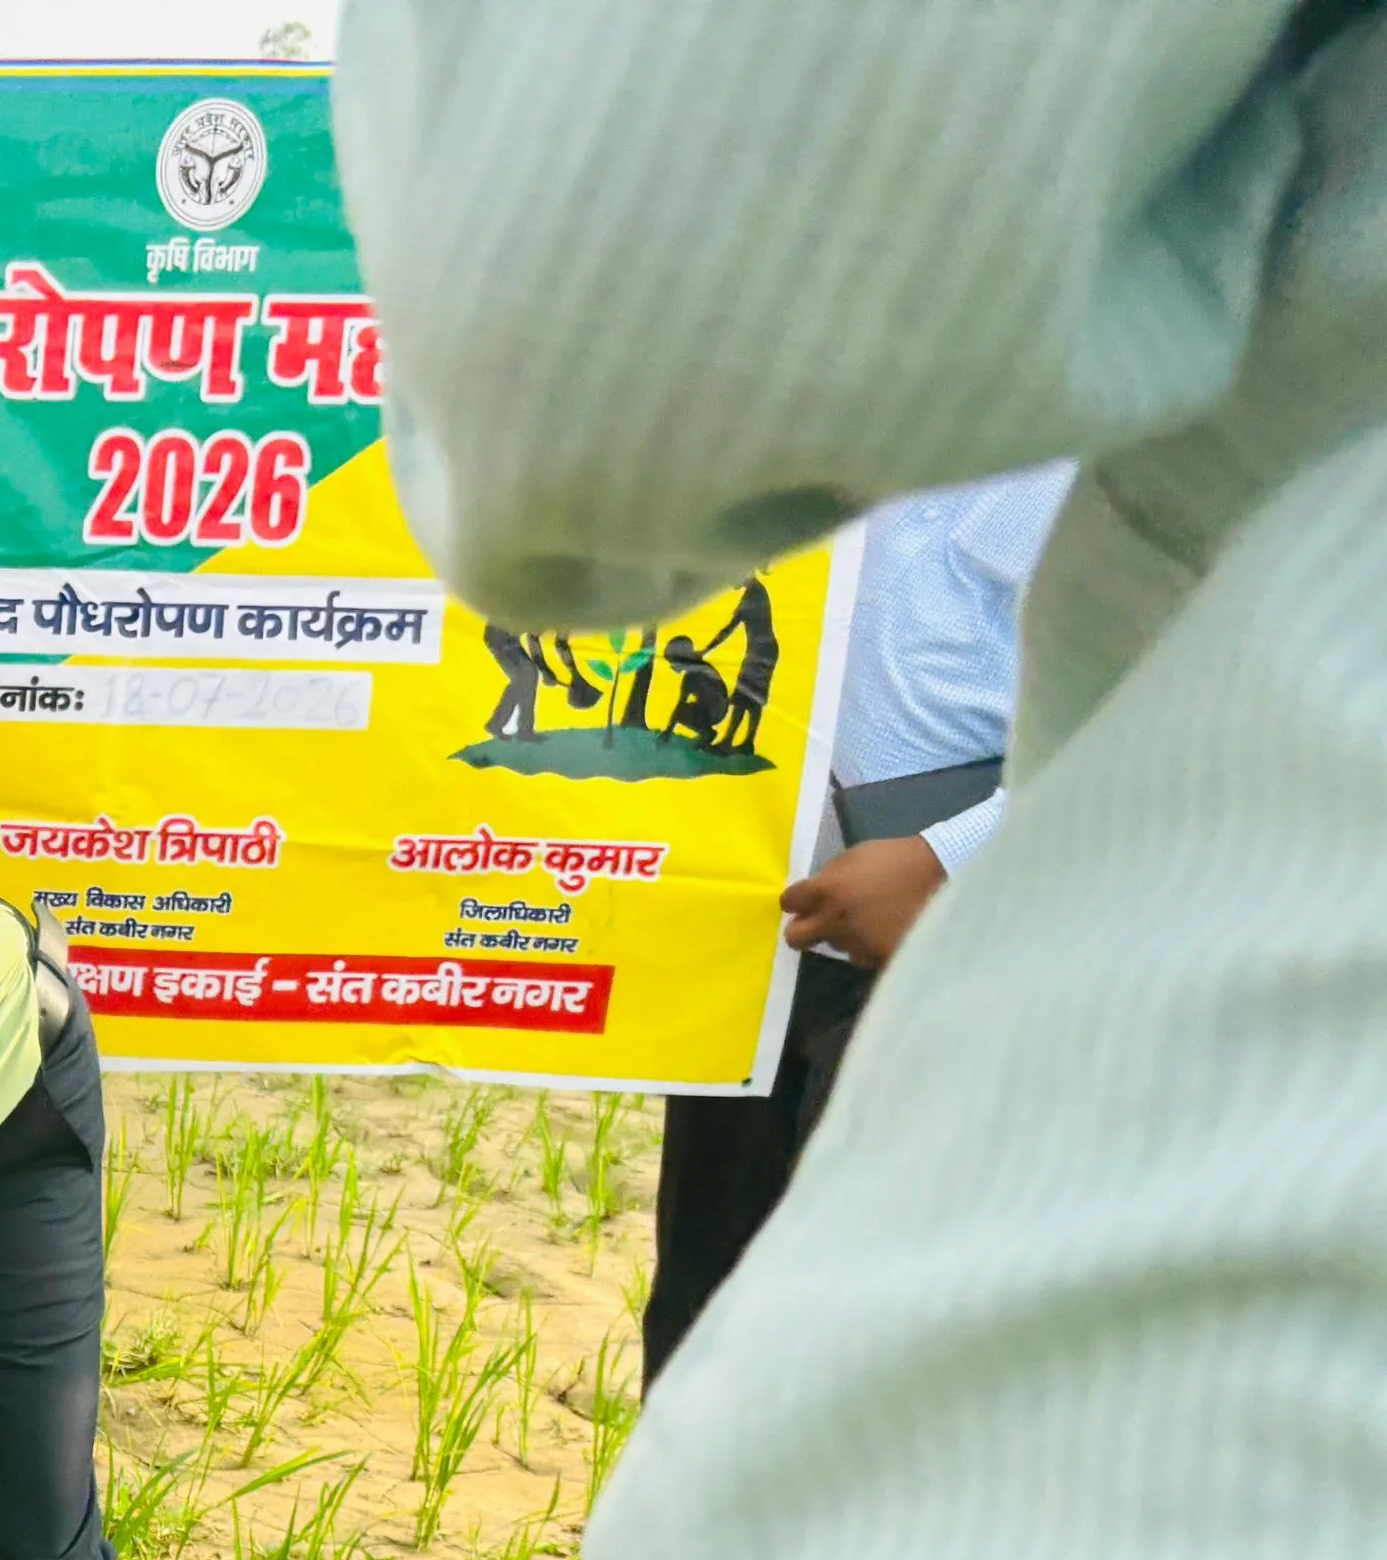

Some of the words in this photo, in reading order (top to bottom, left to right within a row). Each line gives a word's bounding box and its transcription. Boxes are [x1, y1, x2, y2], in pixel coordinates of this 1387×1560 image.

[146, 237, 190, 284] कृषि
[193, 238, 259, 273] विभाग
[86, 431, 308, 544] 2026
[32, 582, 229, 639] पौधरोपण
[237, 591, 428, 648] कार्यक्रम
[0, 815, 153, 862] जयकेश
[157, 816, 284, 866] त्रिपाठी
[389, 825, 541, 873] आलोक
[544, 842, 666, 892] कुमार
[86, 887, 146, 910] विकास
[153, 891, 232, 913] अधिकारी
[460, 898, 572, 923] जिलाधिकारी
[65, 915, 95, 936] संत
[99, 918, 148, 939] कबीर
[150, 925, 195, 940] नगर
[444, 928, 475, 948] संत
[479, 930, 530, 950] कबीर
[532, 936, 579, 953] नगर
[154, 957, 271, 1006] इकाई
[306, 961, 373, 1005] संत
[382, 964, 486, 1008] कबीर
[492, 979, 594, 1014] नगर
